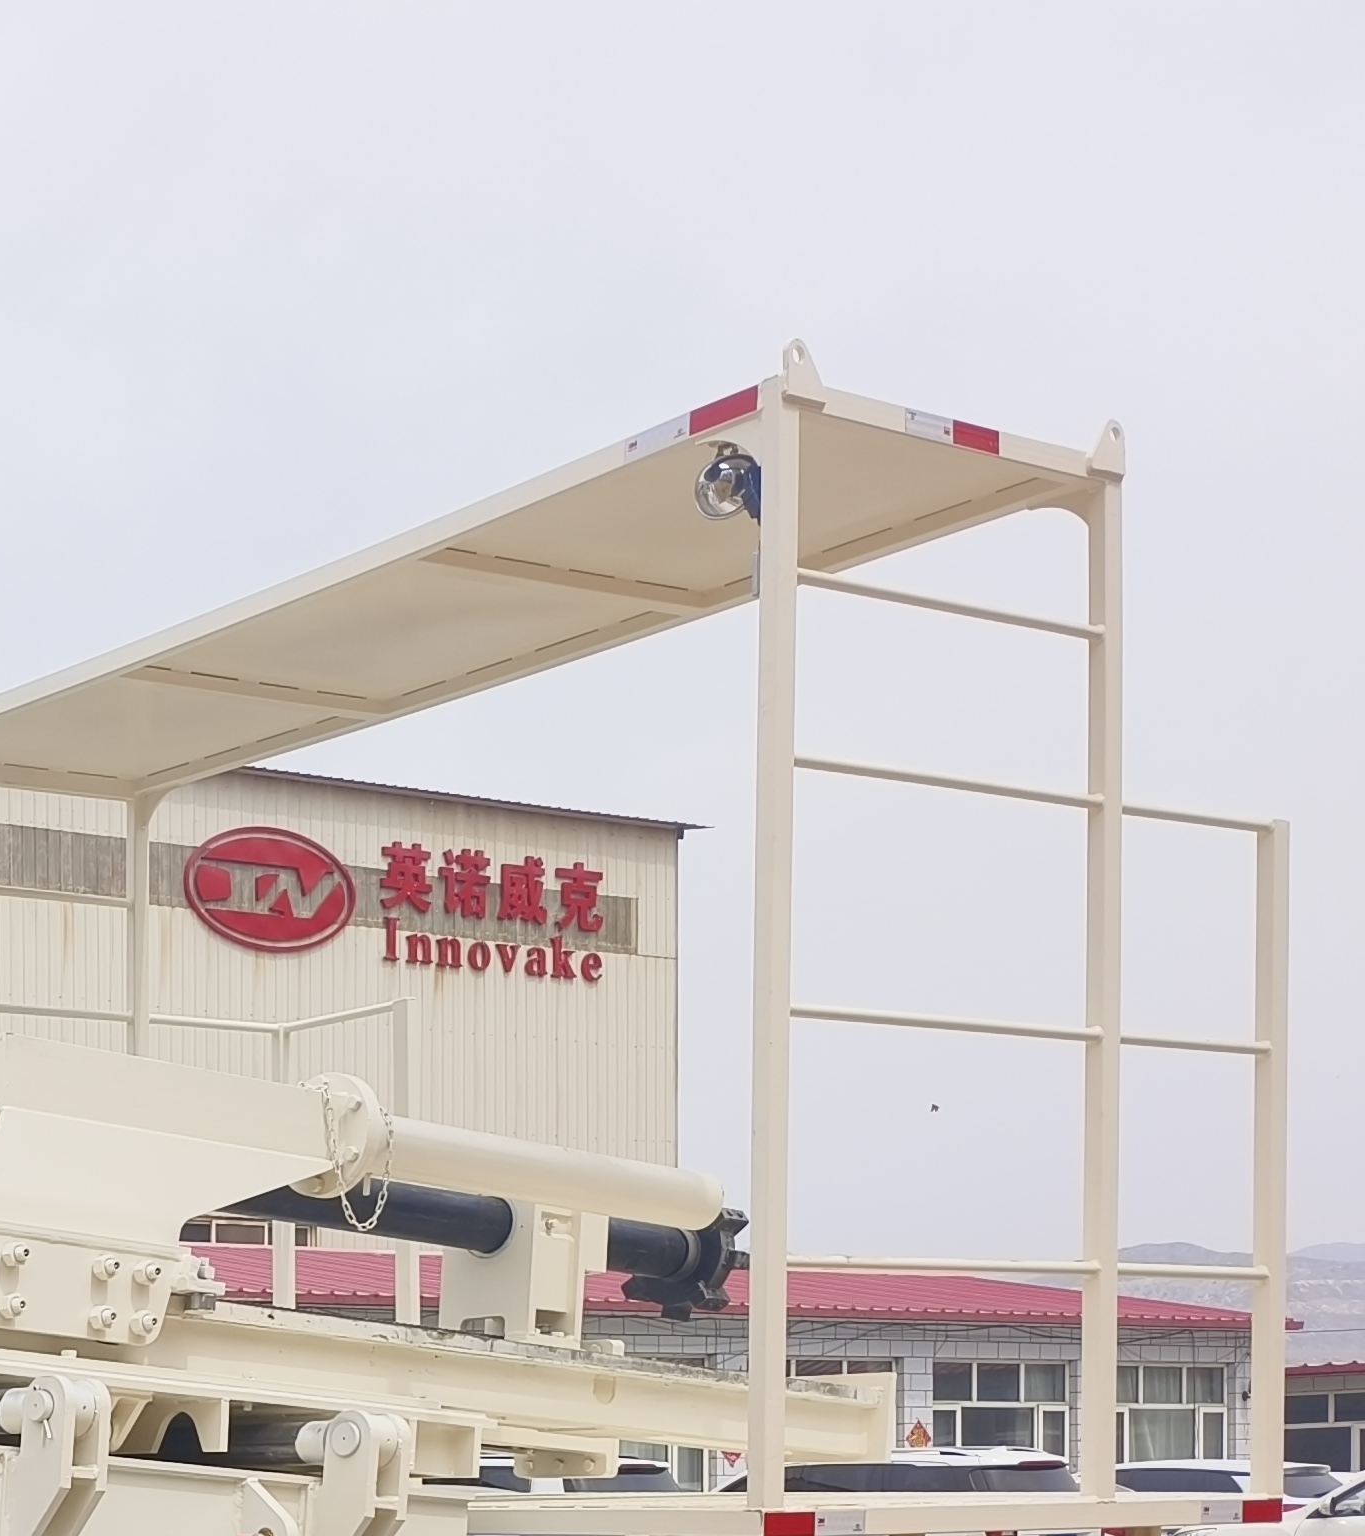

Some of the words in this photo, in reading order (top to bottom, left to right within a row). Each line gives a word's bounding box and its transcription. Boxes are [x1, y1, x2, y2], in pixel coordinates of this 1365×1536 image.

[380, 842, 604, 932] 英诺威克
[381, 916, 604, 982] Innovake
